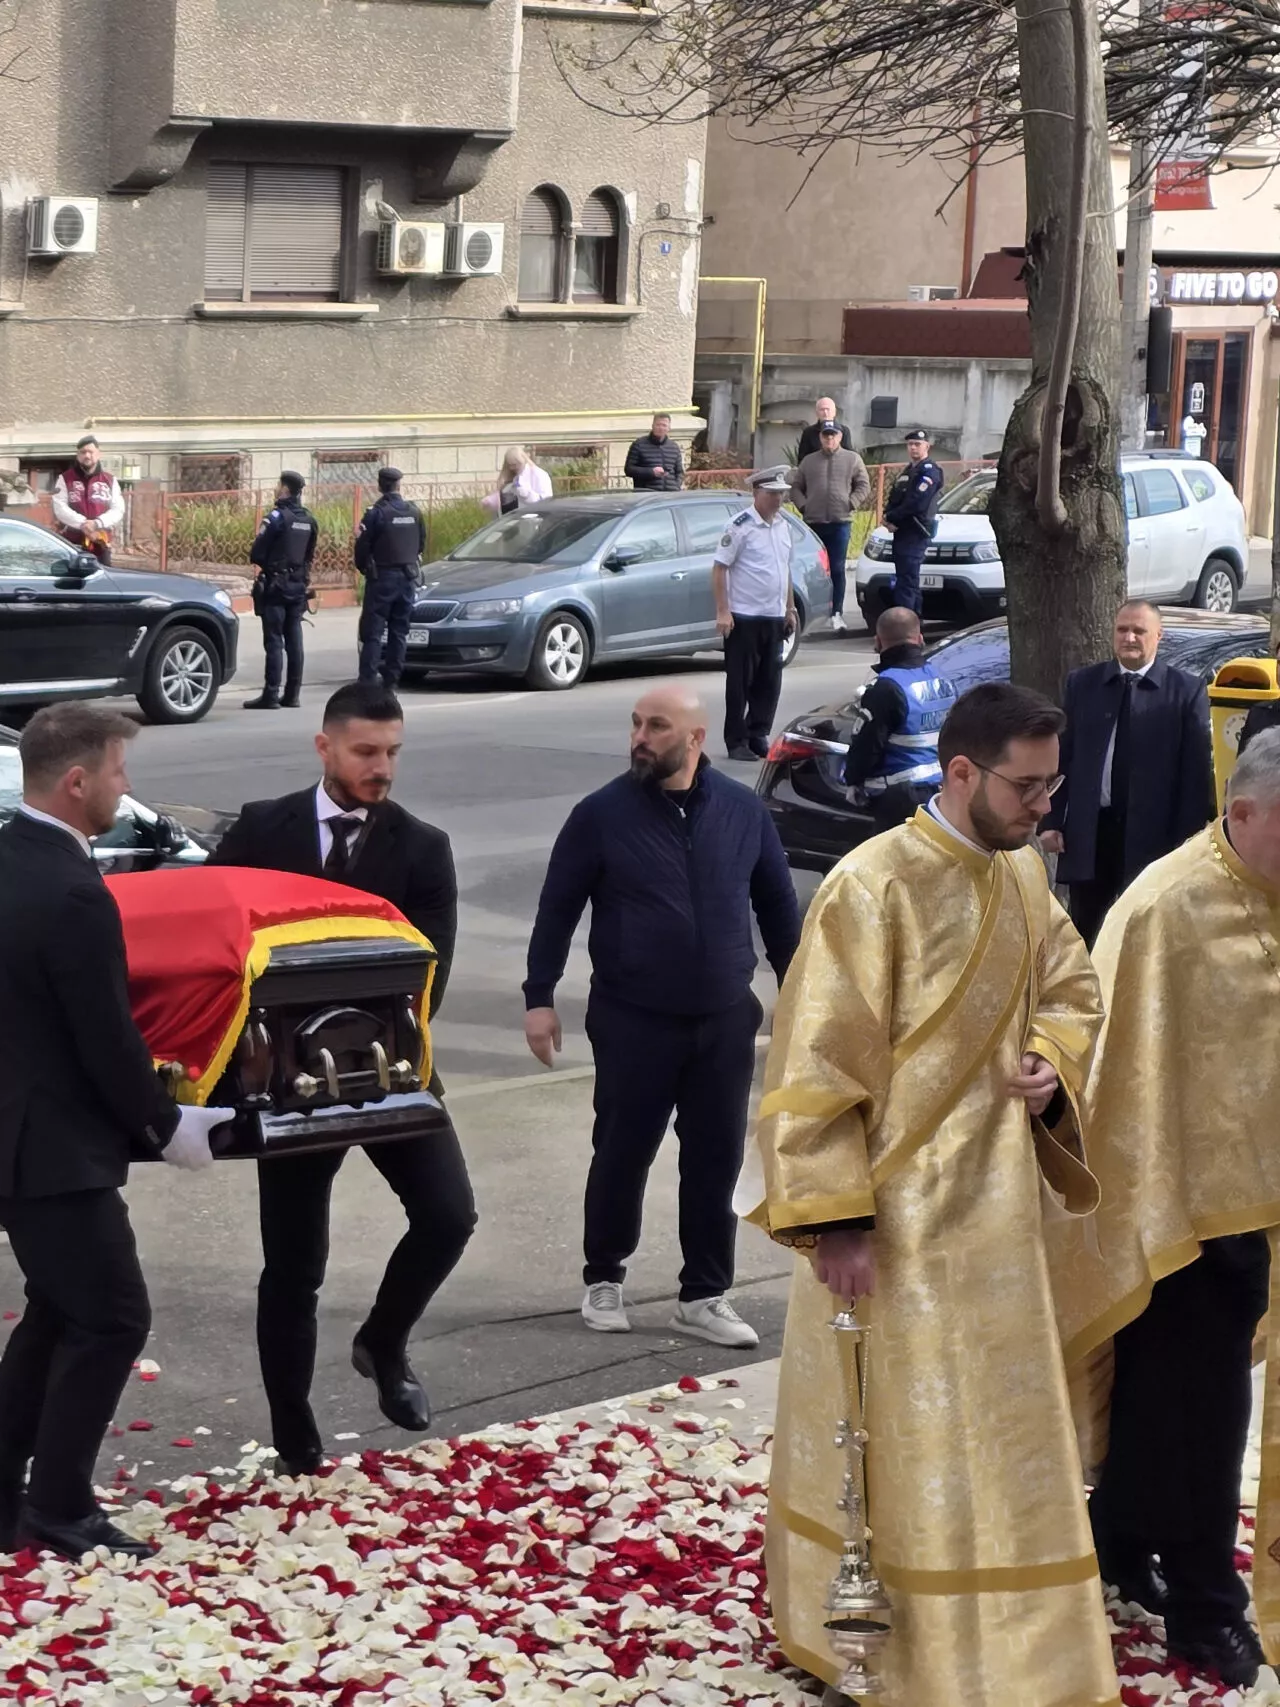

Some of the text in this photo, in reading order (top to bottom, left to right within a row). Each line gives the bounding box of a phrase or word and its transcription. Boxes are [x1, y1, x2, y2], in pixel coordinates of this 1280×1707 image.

[1171, 272, 1217, 299] FIVE
[1217, 272, 1245, 299] TO
[1246, 271, 1278, 299] GO
